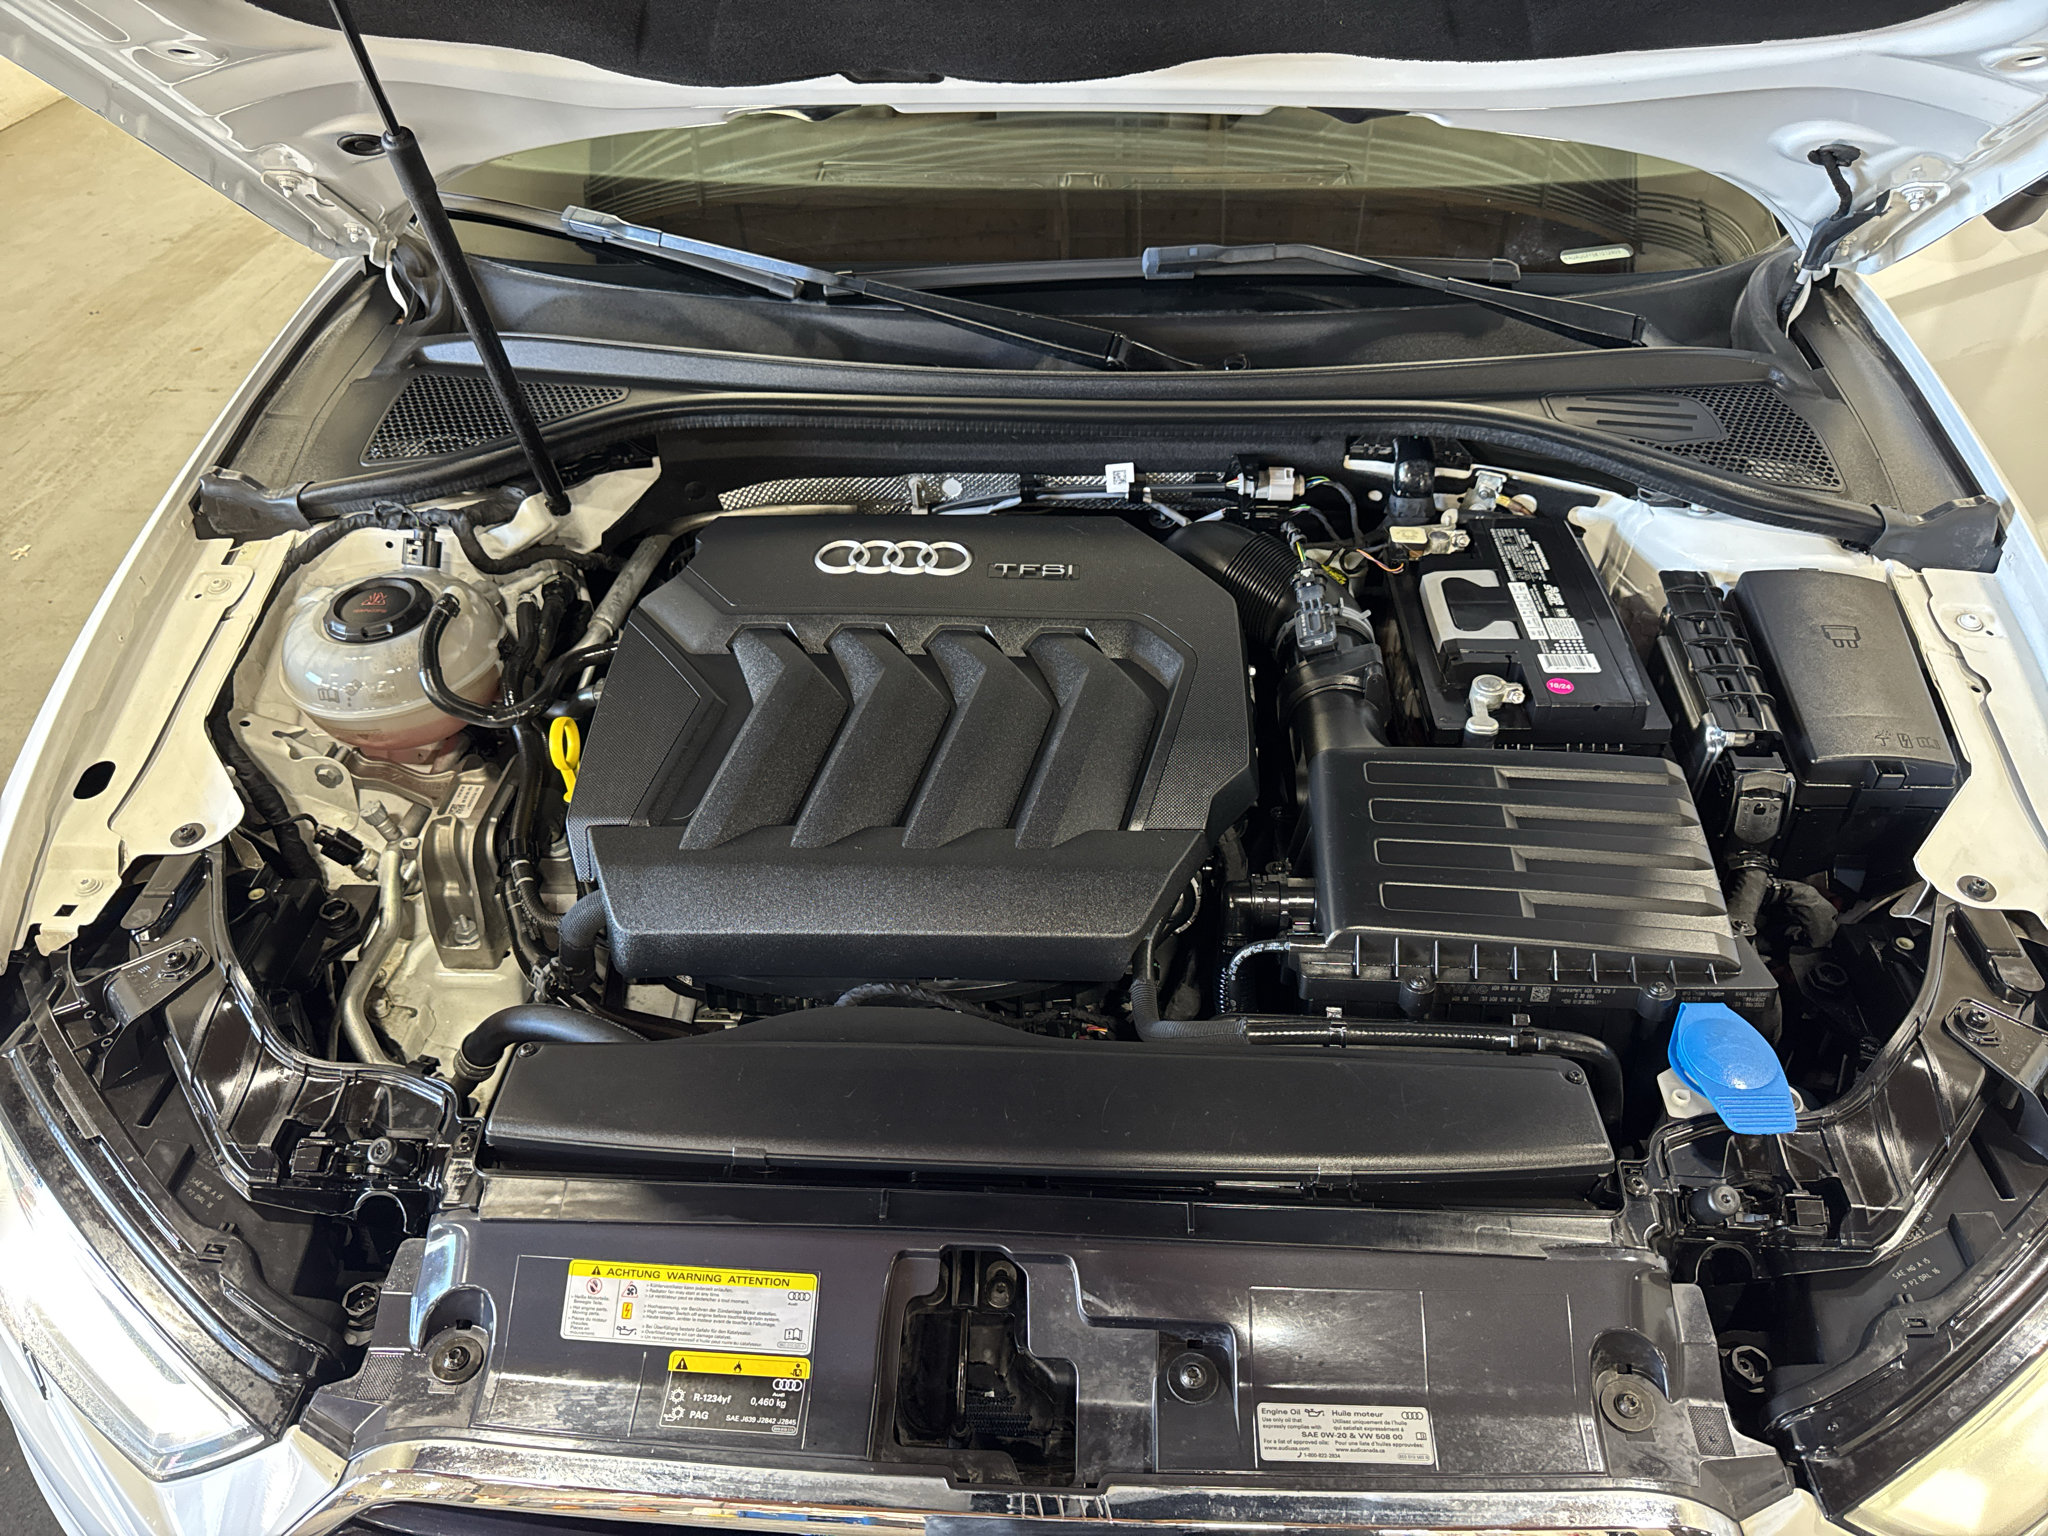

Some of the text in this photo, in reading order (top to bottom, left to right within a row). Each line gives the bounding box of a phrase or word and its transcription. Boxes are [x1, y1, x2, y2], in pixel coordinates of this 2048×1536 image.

[994, 563, 1073, 578] TFSI
[606, 1268, 790, 1287] ACHTUNG WARNING ATTENTION
[693, 1393, 786, 1409] R-1234yf 0,460 kg
[689, 1411, 709, 1420] PAG
[725, 1414, 739, 1422] SAE
